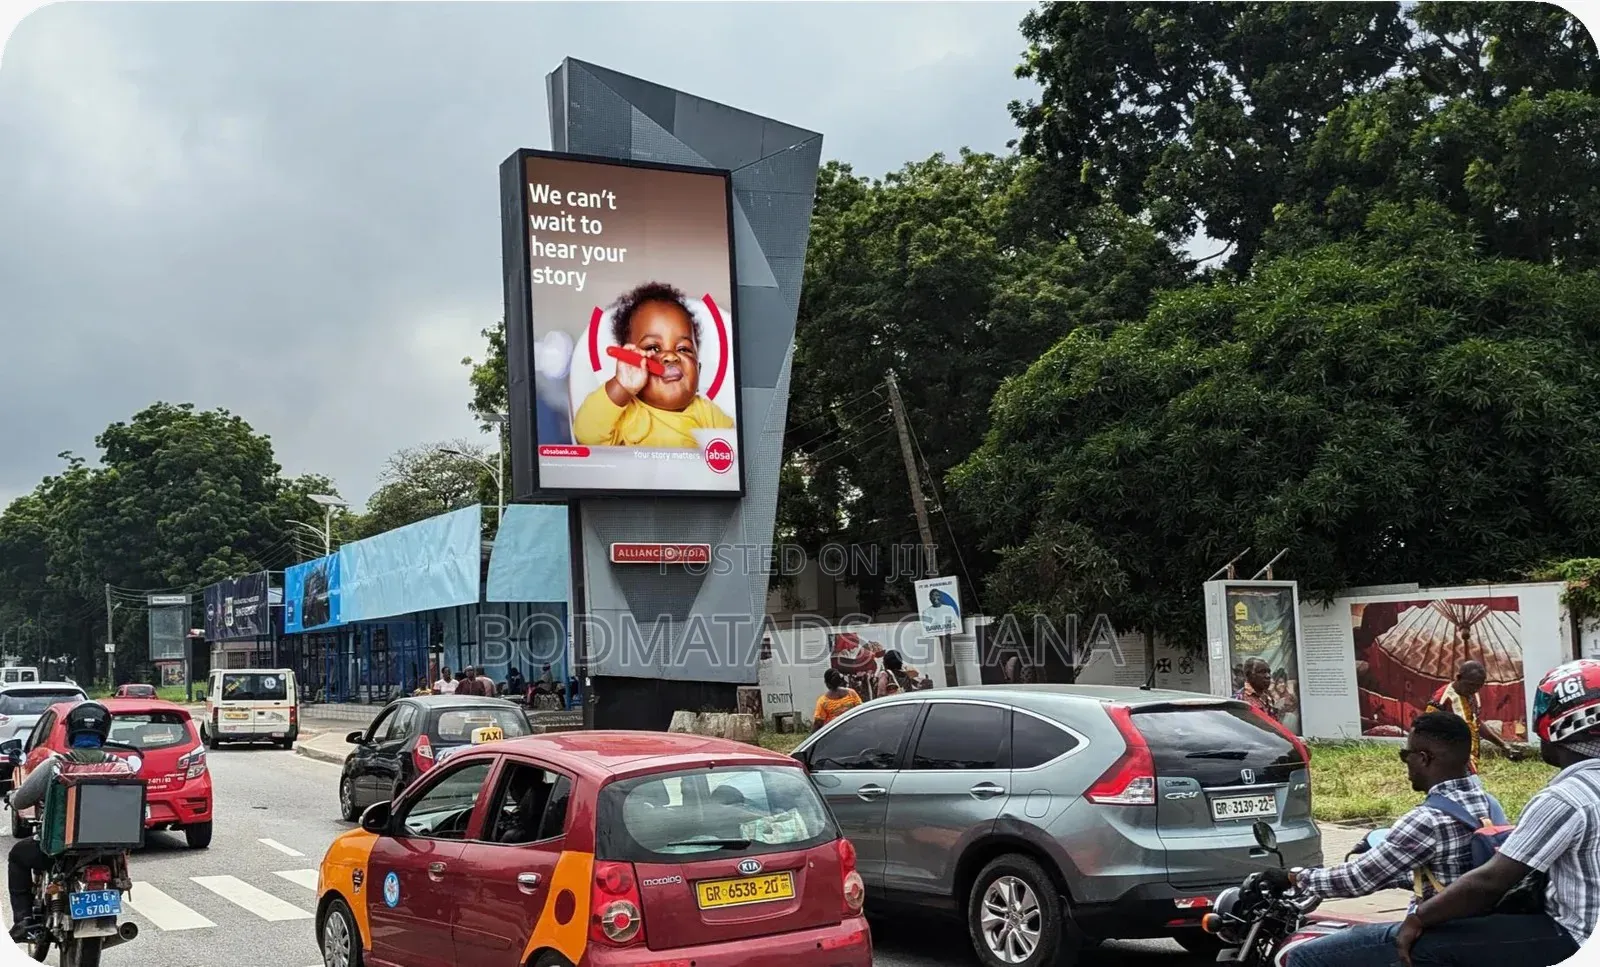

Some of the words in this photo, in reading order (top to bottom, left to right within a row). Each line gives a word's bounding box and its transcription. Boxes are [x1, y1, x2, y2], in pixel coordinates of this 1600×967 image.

[529, 182, 562, 206] We
[566, 189, 617, 210] can't
[530, 211, 576, 234] wait
[580, 215, 603, 235] to
[531, 235, 578, 259] hear
[581, 245, 628, 266] your
[532, 265, 587, 291] story
[633, 450, 651, 460] Your
[651, 452, 671, 462] story
[671, 453, 700, 461] matters
[708, 449, 731, 461] absa
[618, 548, 665, 558] ALLIANCE
[674, 548, 706, 558] MEDIA
[1234, 623, 1263, 634] Special
[1553, 677, 1580, 699] 16
[767, 693, 793, 704] IDENTITY
[1558, 691, 1583, 704] YEARS
[480, 731, 502, 742] TAXI
[1215, 802, 1228, 815] GR
[1232, 795, 1270, 814] 3139-22
[741, 862, 758, 871] KIA
[643, 874, 682, 887] morning
[705, 886, 721, 902] GR
[86, 904, 110, 915] 6700
